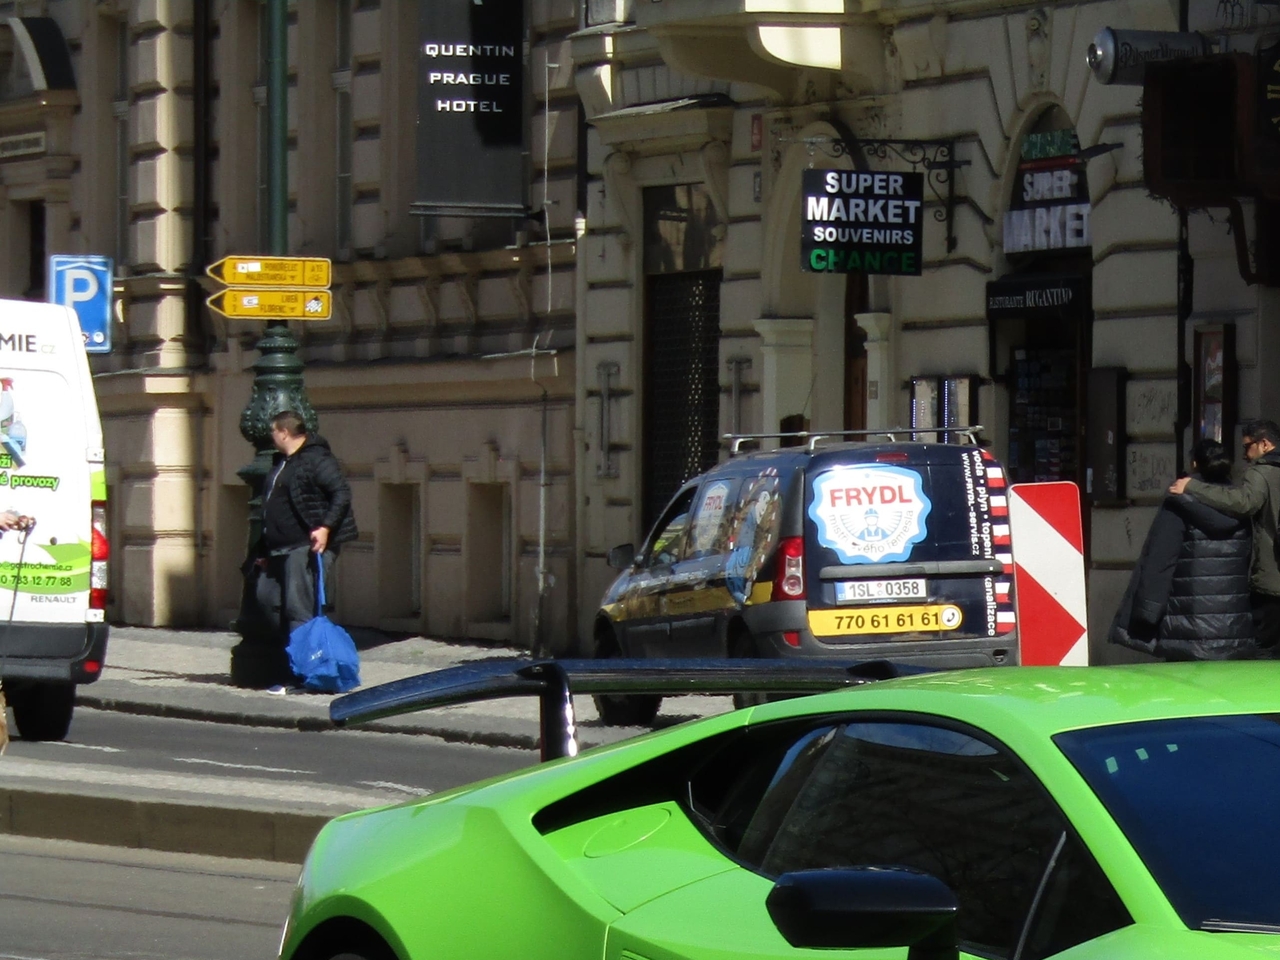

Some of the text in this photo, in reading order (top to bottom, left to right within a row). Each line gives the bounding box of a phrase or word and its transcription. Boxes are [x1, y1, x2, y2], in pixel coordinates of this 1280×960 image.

[426, 44, 515, 57] QUENTIN
[430, 73, 510, 85] PRAGUE
[437, 101, 503, 112] HOTEL
[826, 172, 904, 196] SUPER
[1022, 170, 1076, 202] SUPER
[808, 197, 921, 224] MARKET
[814, 227, 914, 244] SOUVENIRS
[1003, 204, 1091, 252] MARKET
[810, 249, 916, 273] CHANGE
[65, 269, 99, 308] P
[971, 450, 984, 477] voda
[11, 475, 60, 491] provozy
[830, 485, 913, 507] FRYDL
[976, 486, 989, 512] plyn
[981, 521, 993, 560] topení
[32, 576, 43, 586] 12
[45, 576, 58, 587] 77
[60, 577, 72, 587] 88
[849, 581, 920, 598] 1SL 0358
[31, 596, 77, 604] RENAULT
[835, 612, 939, 630] 770 61 61 61
